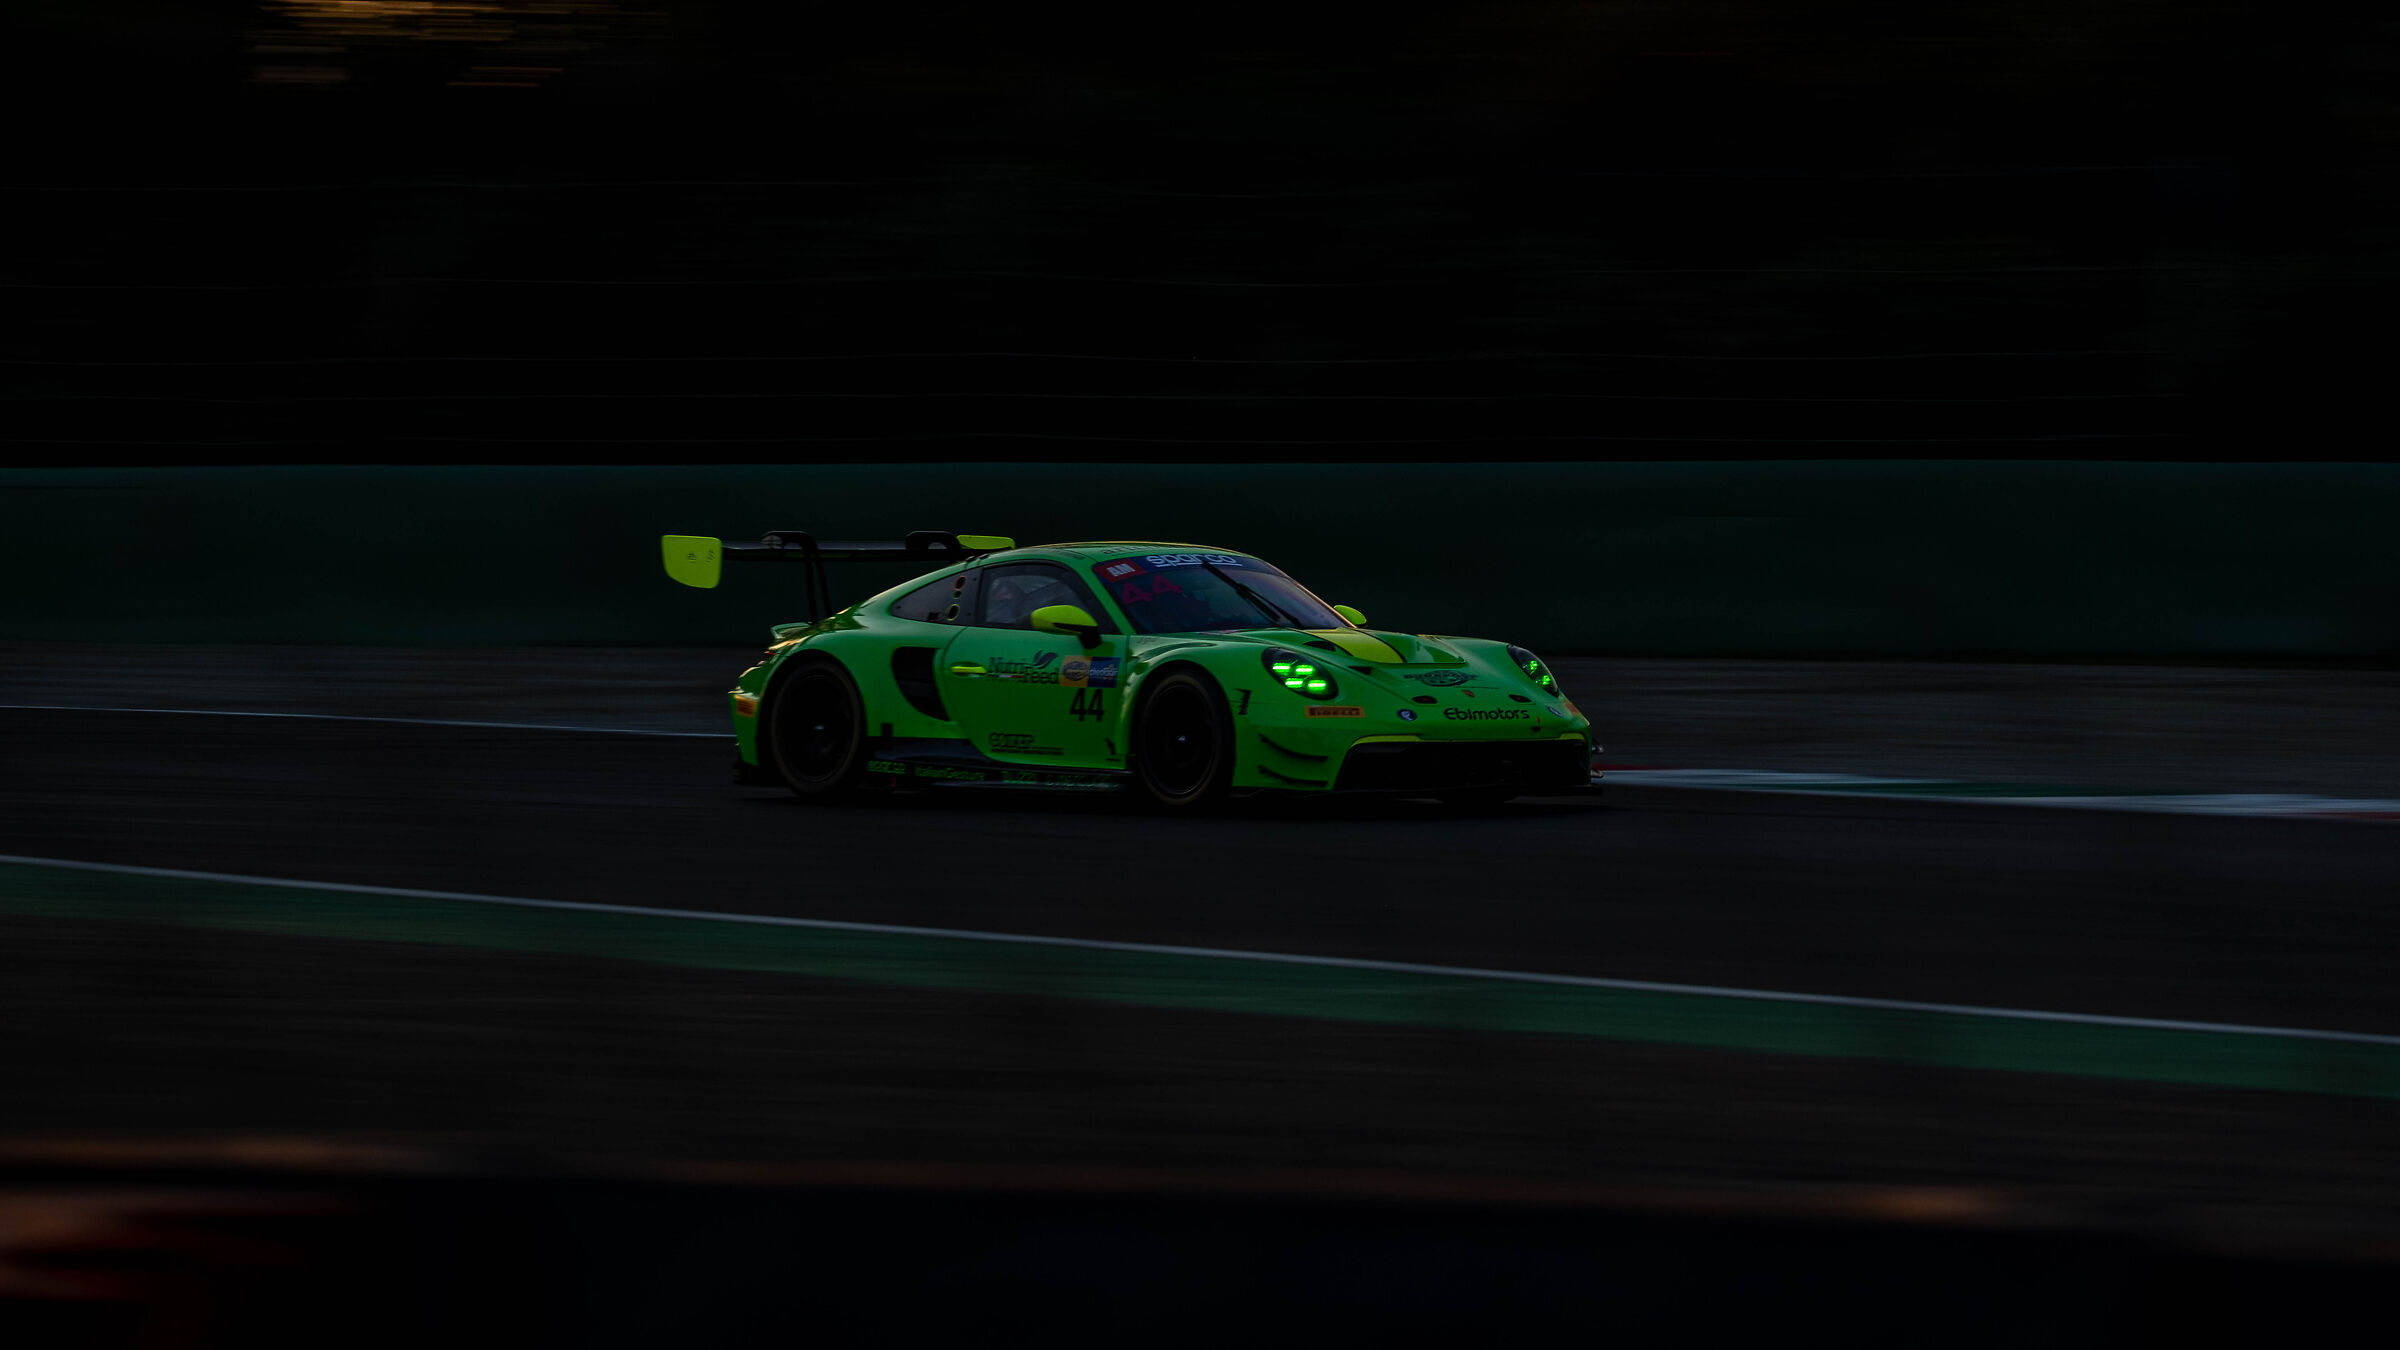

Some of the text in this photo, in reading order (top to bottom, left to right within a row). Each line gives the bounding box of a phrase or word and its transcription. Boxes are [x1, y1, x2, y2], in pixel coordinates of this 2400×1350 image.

[1146, 553, 1242, 567] sparco
[1121, 574, 1184, 607] 44
[1071, 688, 1104, 721] 44
[1444, 707, 1530, 721] Ebimotors
